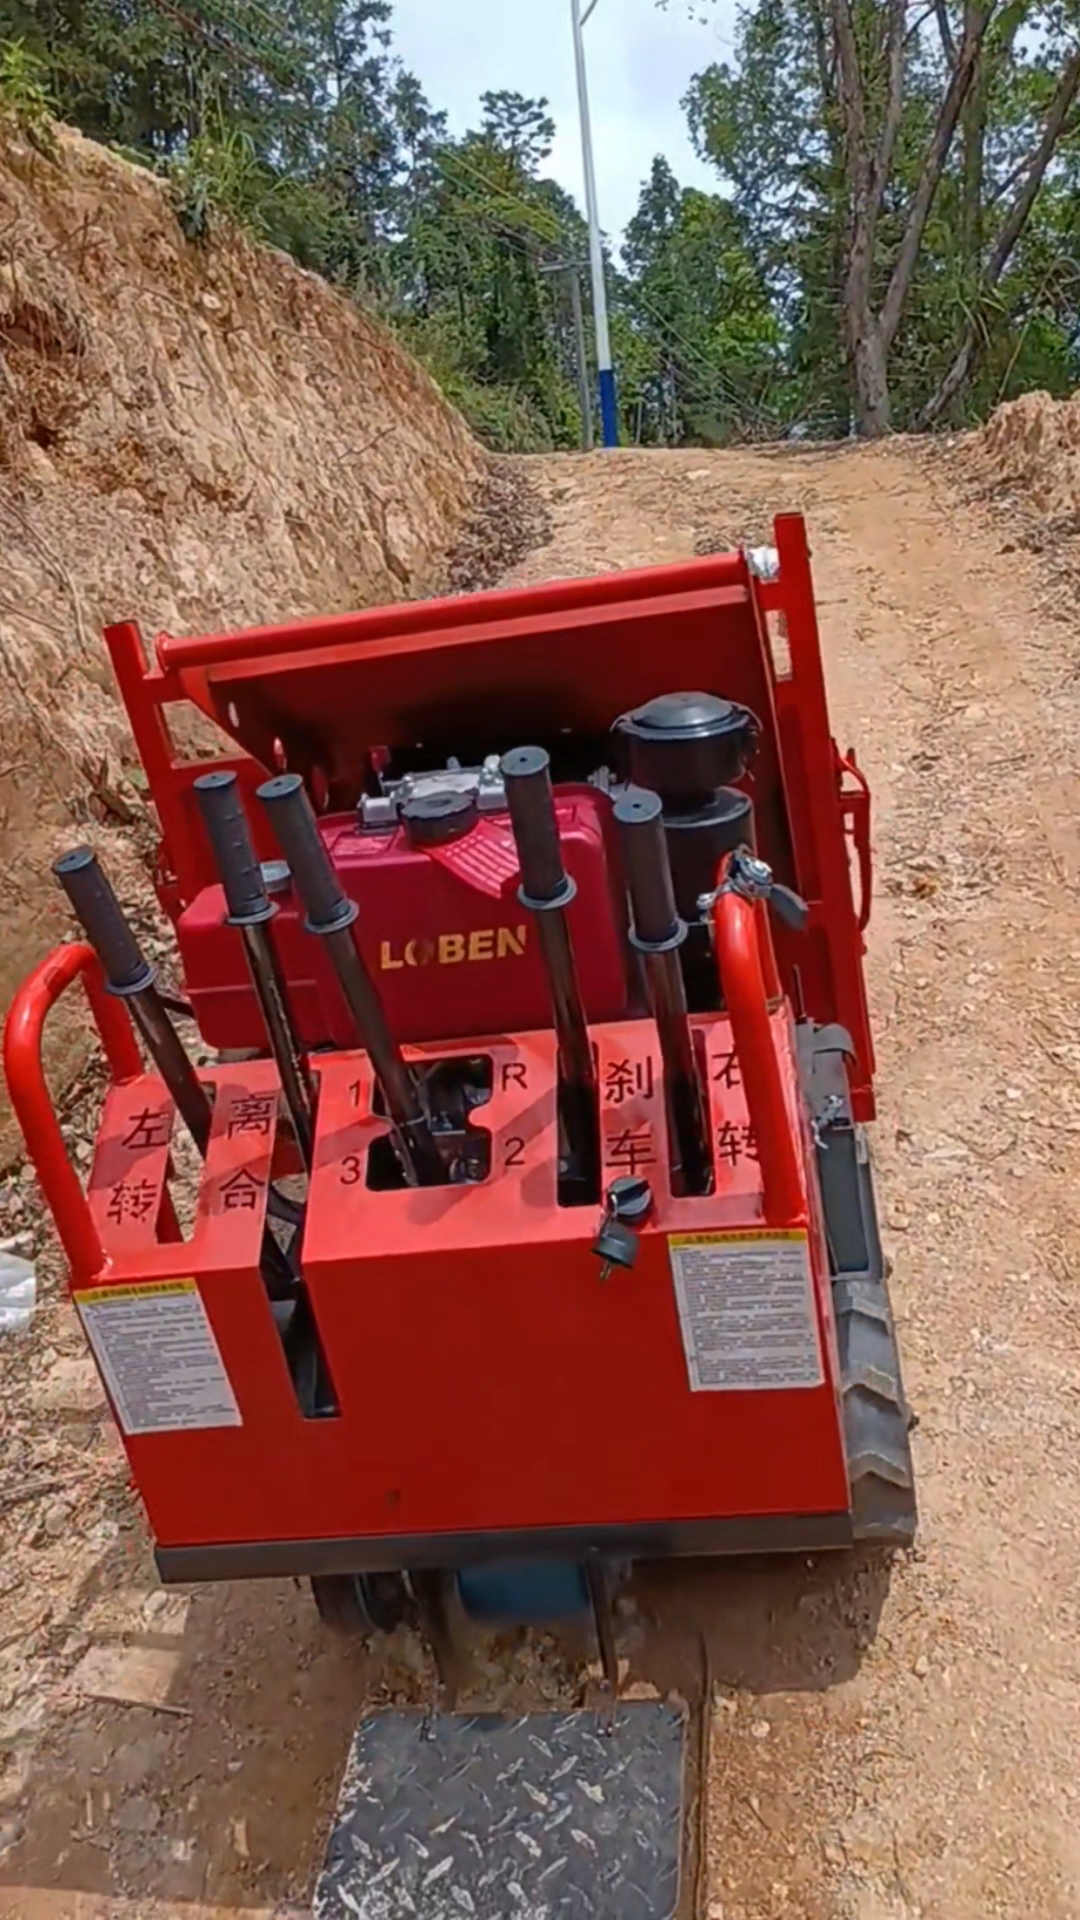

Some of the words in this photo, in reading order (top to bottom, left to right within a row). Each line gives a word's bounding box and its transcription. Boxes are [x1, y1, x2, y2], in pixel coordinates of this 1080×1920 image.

[502, 1063, 527, 1091] R
[348, 1079, 362, 1107] 1
[604, 1056, 657, 1175] 刹车
[107, 1107, 168, 1225] 左转
[219, 1093, 276, 1210] 离合
[504, 1137, 526, 1167] 2
[339, 1156, 361, 1185] 3
